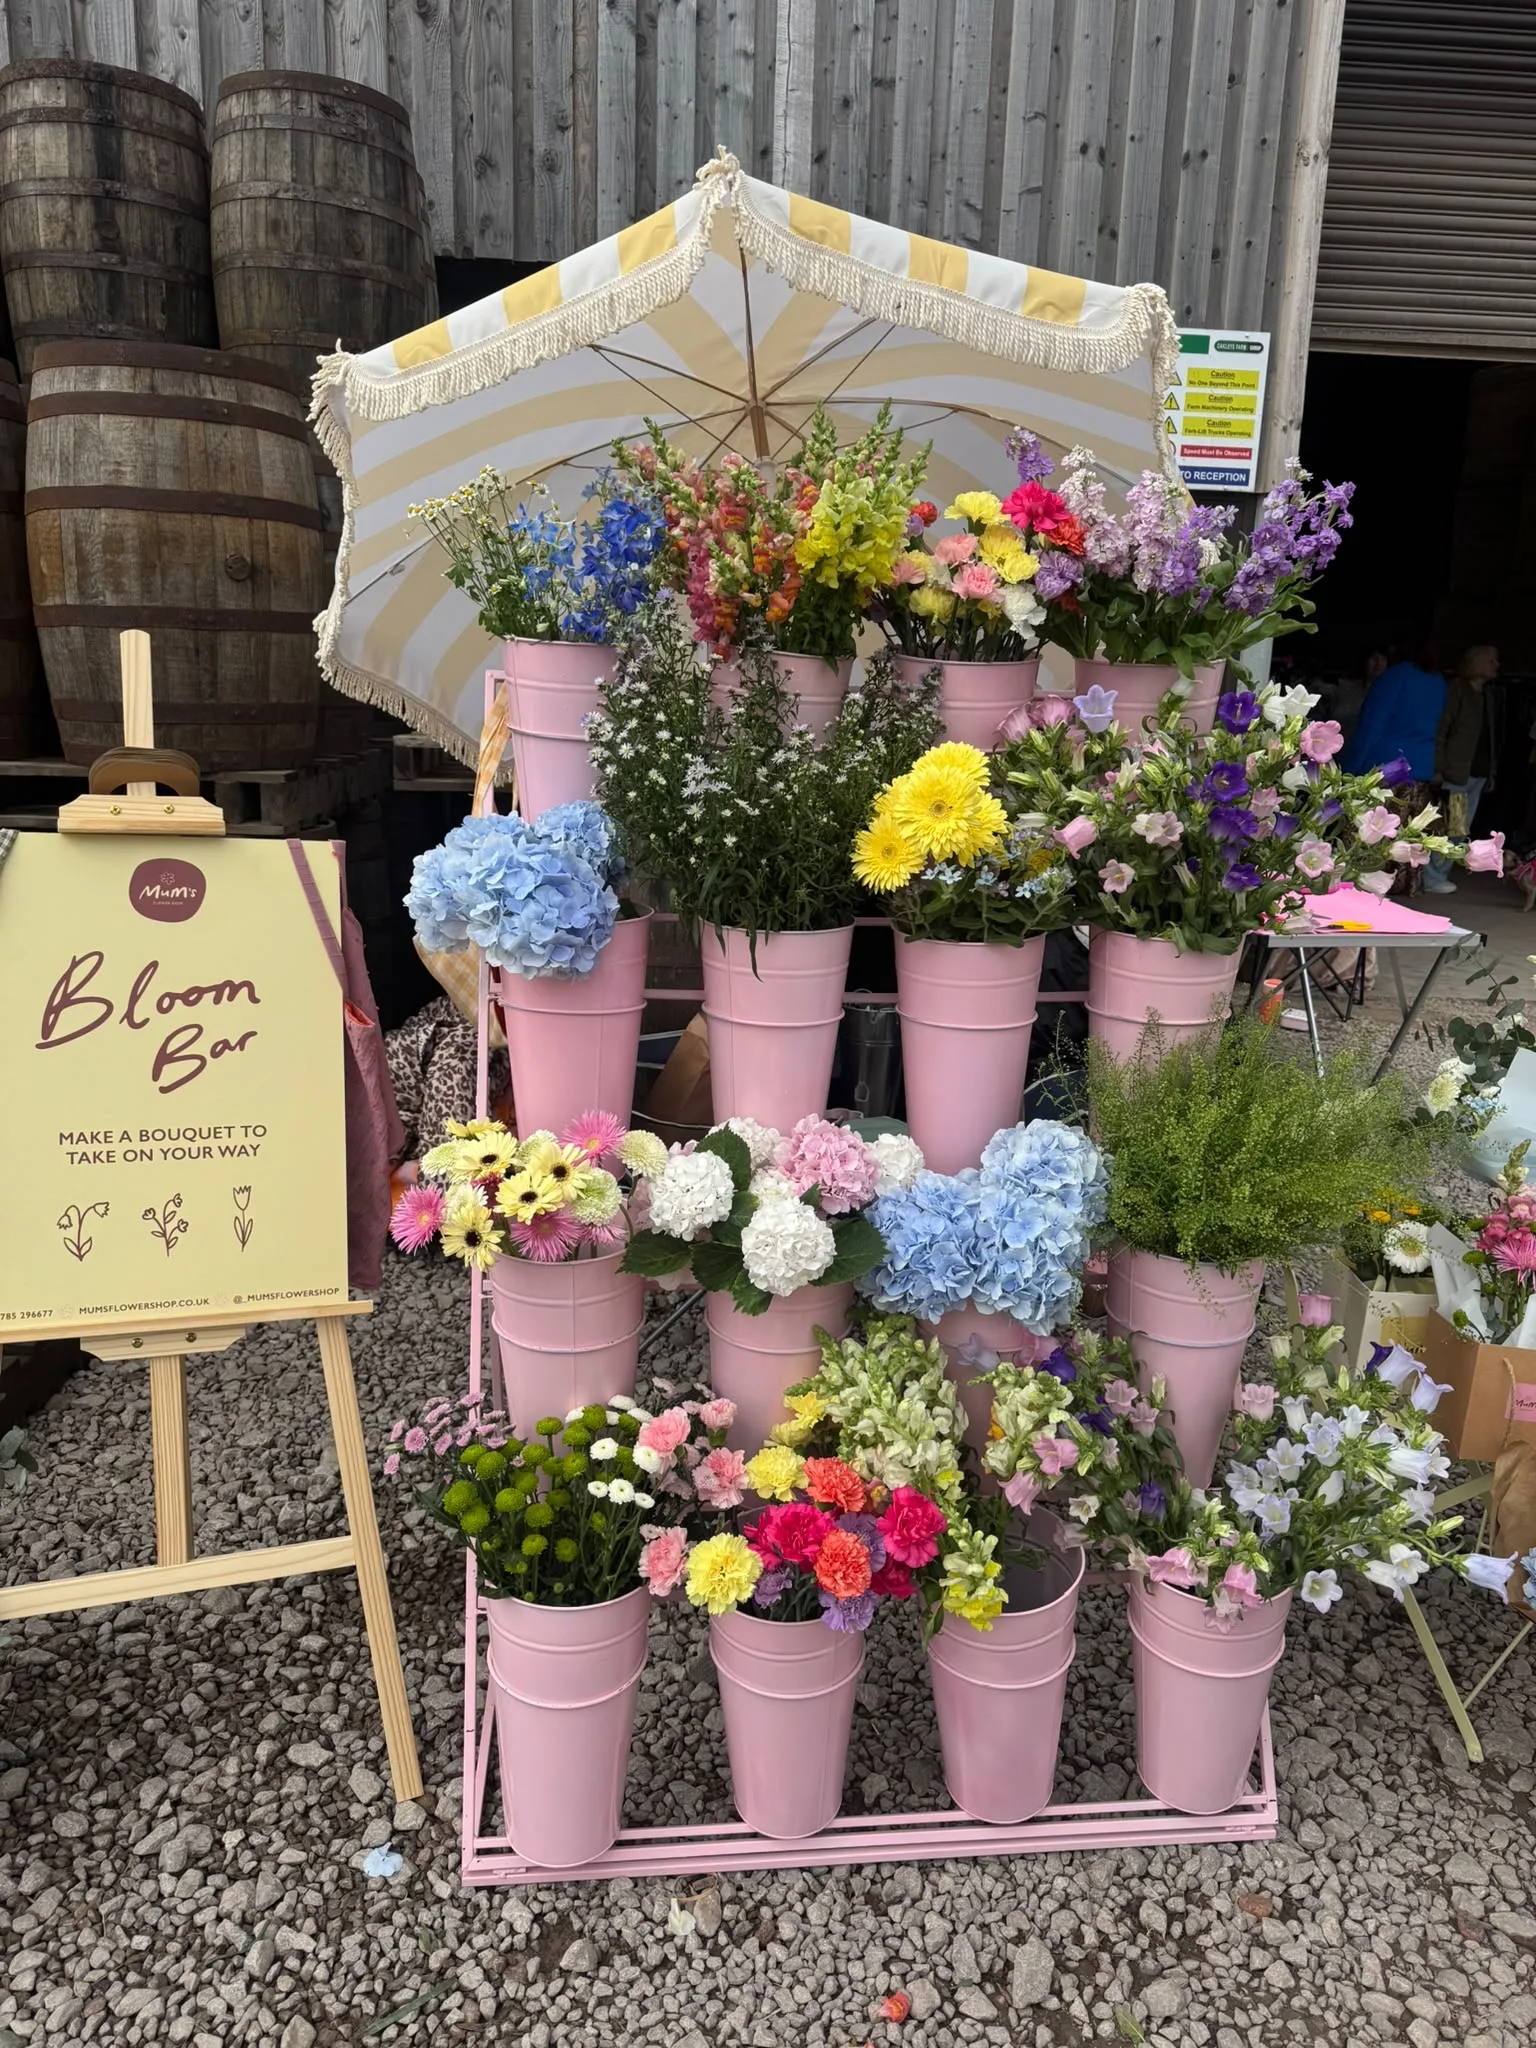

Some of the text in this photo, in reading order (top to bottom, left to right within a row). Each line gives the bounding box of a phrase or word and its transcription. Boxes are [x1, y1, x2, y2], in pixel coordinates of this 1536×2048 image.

[1210, 370, 1235, 380] Caution
[1208, 394, 1233, 403] Caution
[1229, 406, 1255, 414] Operating
[1207, 419, 1231, 428] Caution
[1193, 471, 1247, 482] RECEPTION
[139, 884, 198, 900] Mum's
[35, 951, 261, 1049] Bloom
[152, 1024, 258, 1094] Bar
[59, 1125, 267, 1145] MAKE A BOUQUET TO
[66, 1144, 261, 1165] TAKE ON YOUR WAY
[233, 1288, 340, 1305] @_MUMSFLOWERSHOP
[20, 1310, 53, 1319] 296677
[79, 1298, 210, 1315] MUMSFLOWERSHOP.CO.UK
